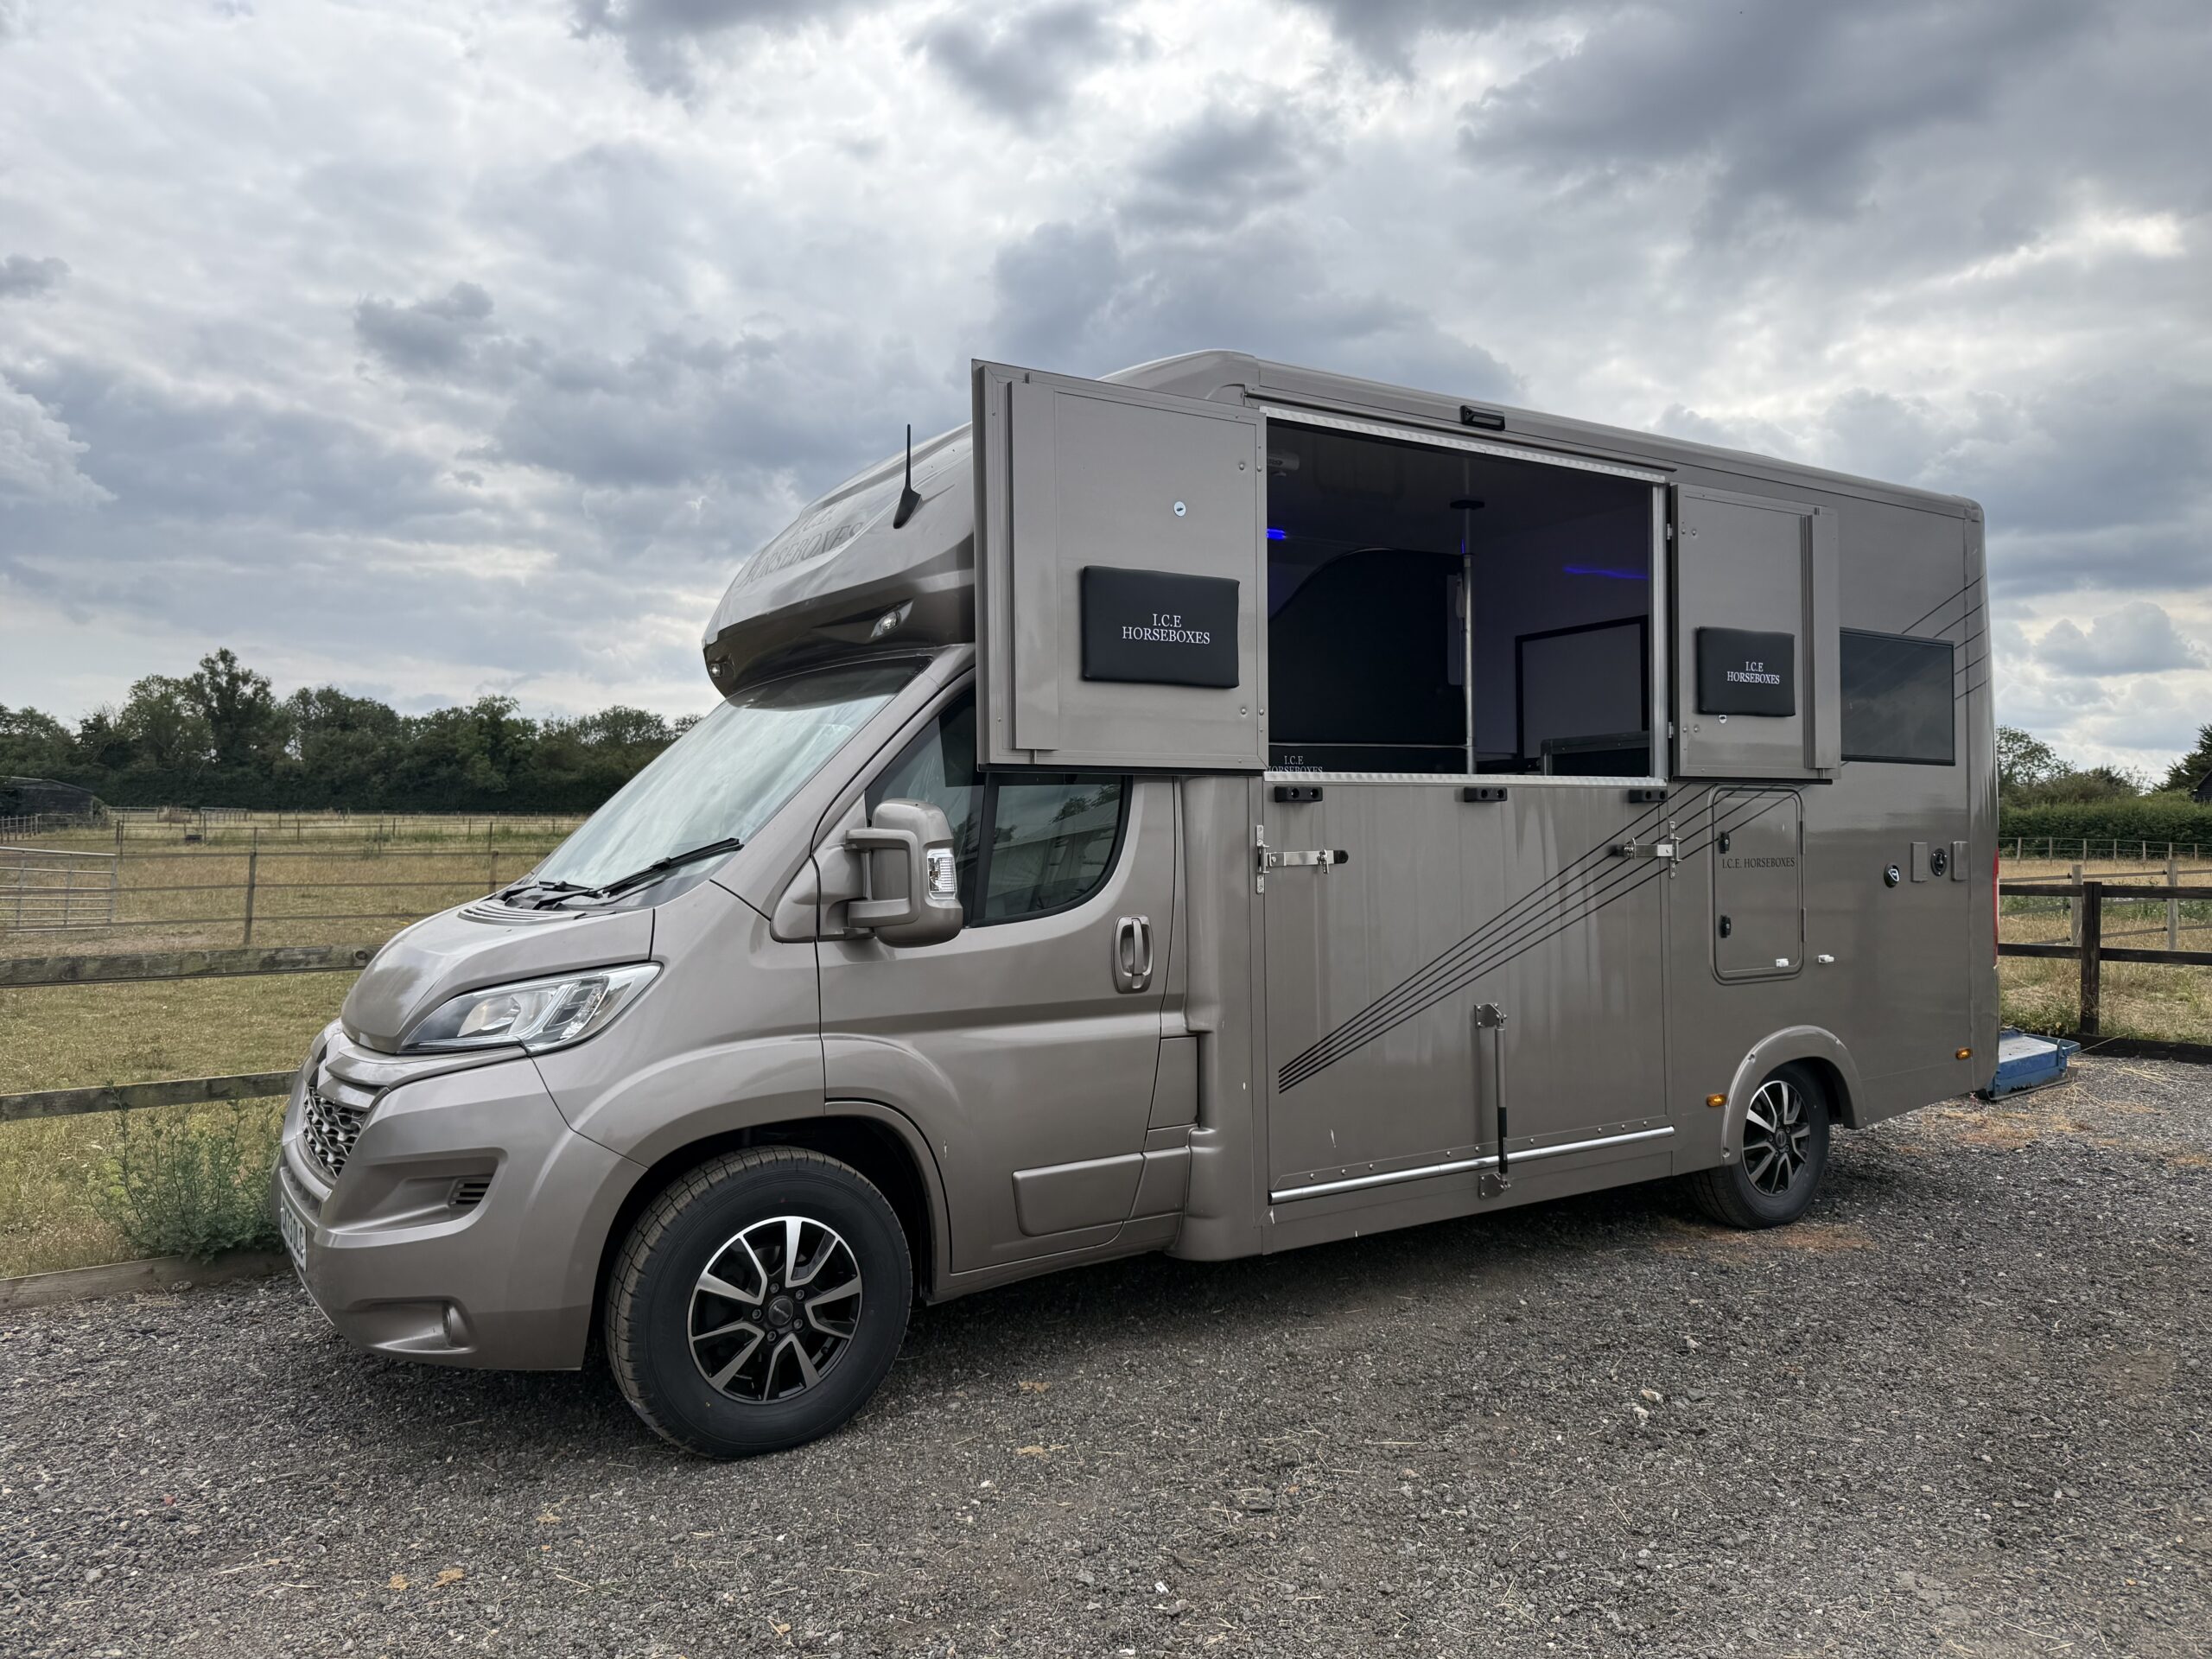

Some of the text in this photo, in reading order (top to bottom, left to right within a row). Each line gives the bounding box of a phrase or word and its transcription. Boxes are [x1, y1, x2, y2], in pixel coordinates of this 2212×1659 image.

[1152, 613, 1182, 628] I.C.E
[1122, 626, 1211, 645] HORSEBOXES
[1745, 661, 1764, 672] I.C.E
[1726, 671, 1780, 685] HORSEBOXES
[1284, 755, 1304, 765] I.C.E
[1744, 857, 1796, 868] HORSEBOXES
